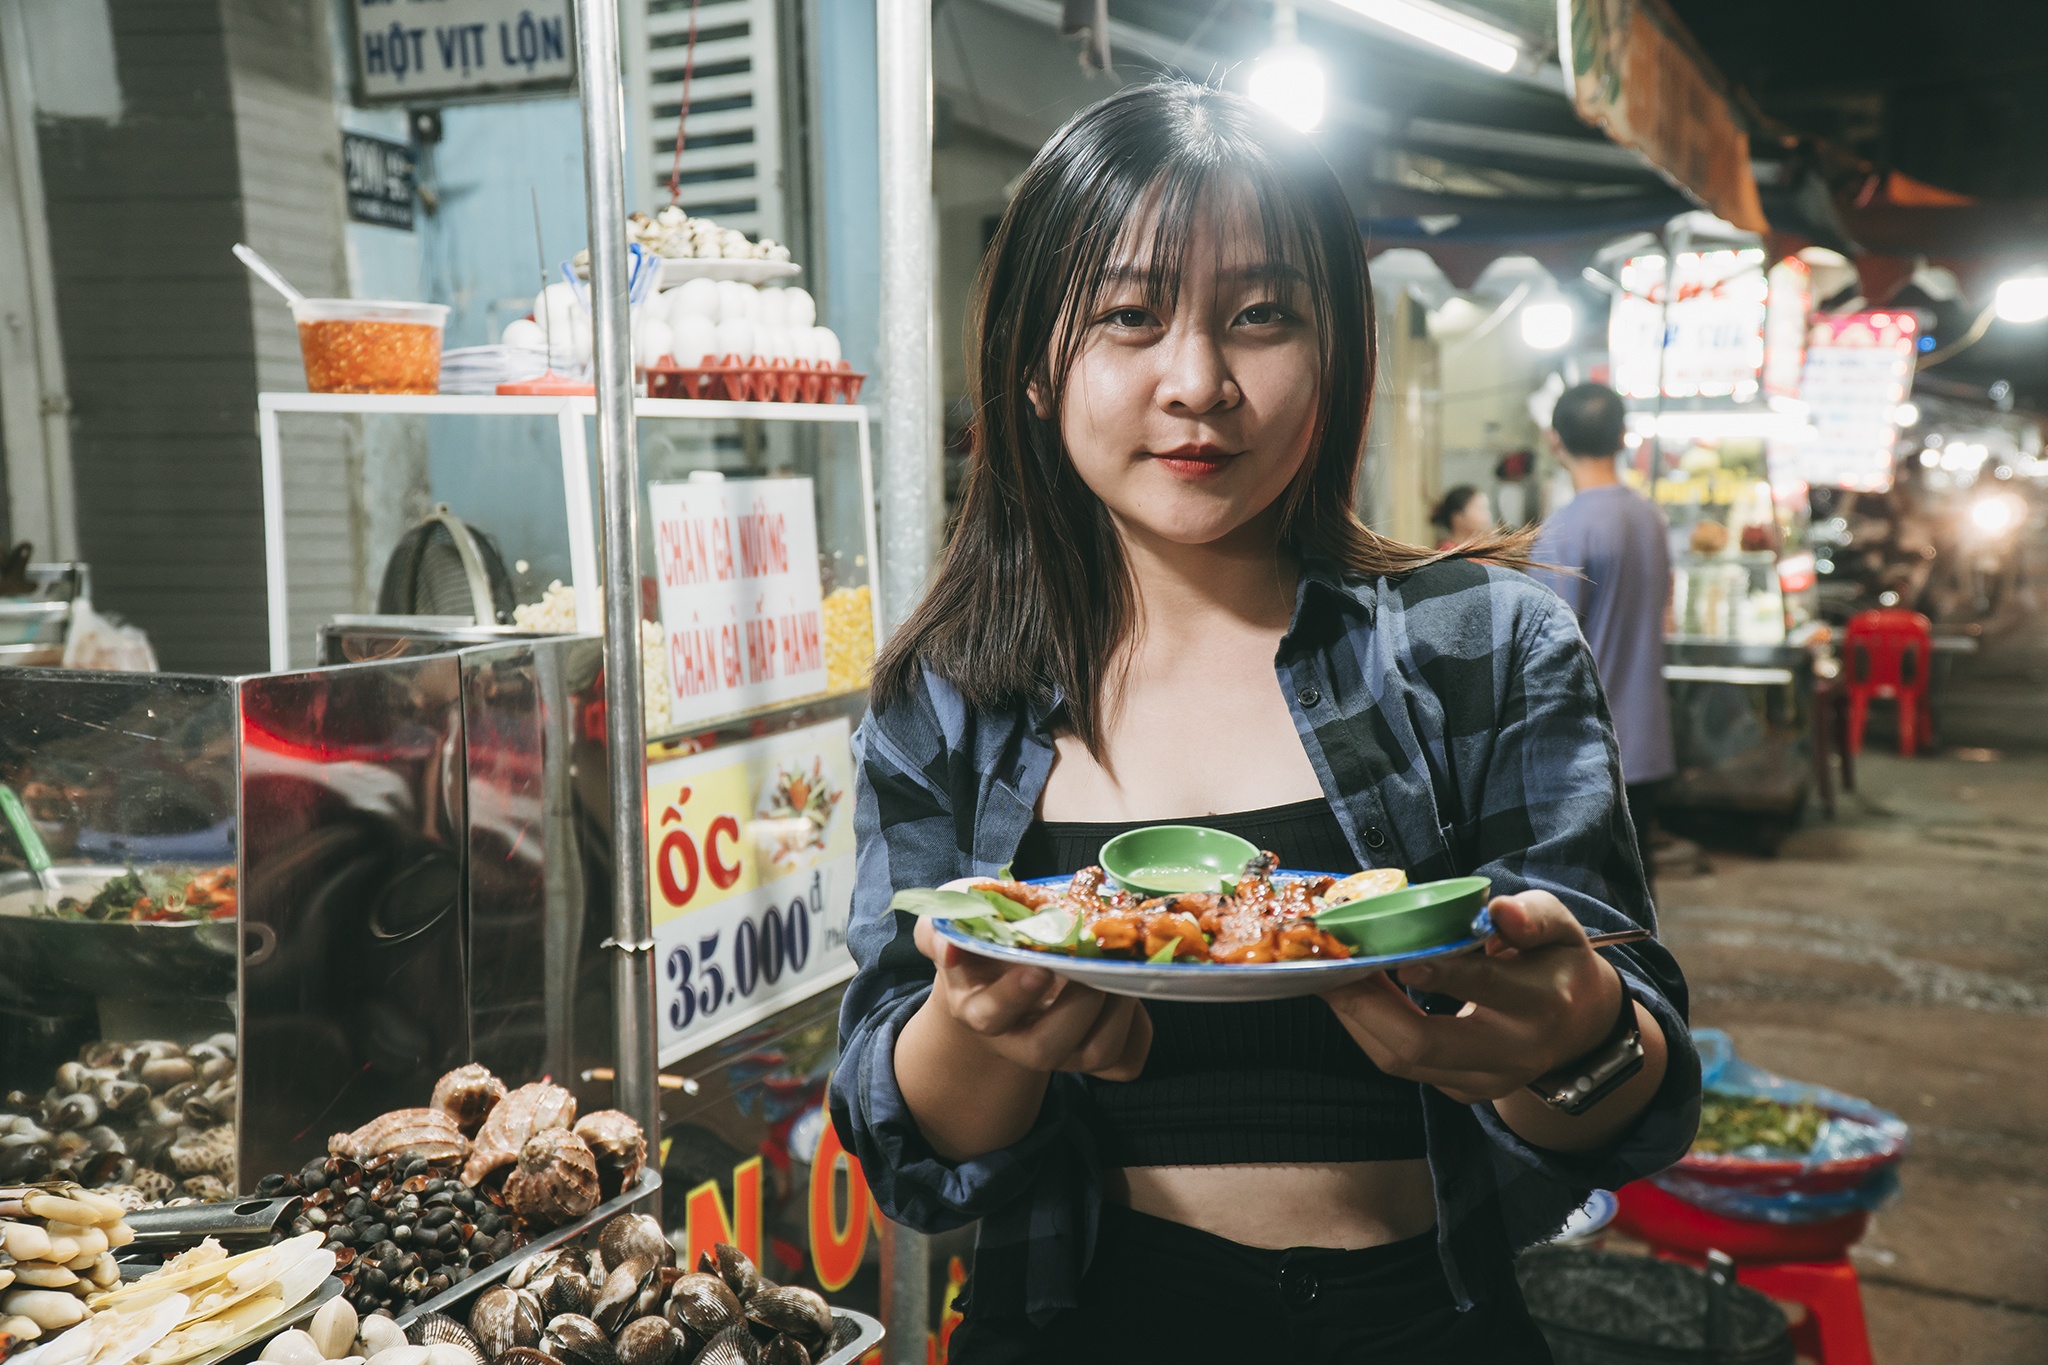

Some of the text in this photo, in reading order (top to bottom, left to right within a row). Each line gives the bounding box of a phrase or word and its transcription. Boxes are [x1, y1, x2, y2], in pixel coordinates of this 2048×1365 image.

[365, 9, 564, 80] HỘT VỊT LỘN
[661, 501, 708, 588] CHÂN
[672, 611, 718, 699] CHÂN
[656, 785, 742, 907] ỐC
